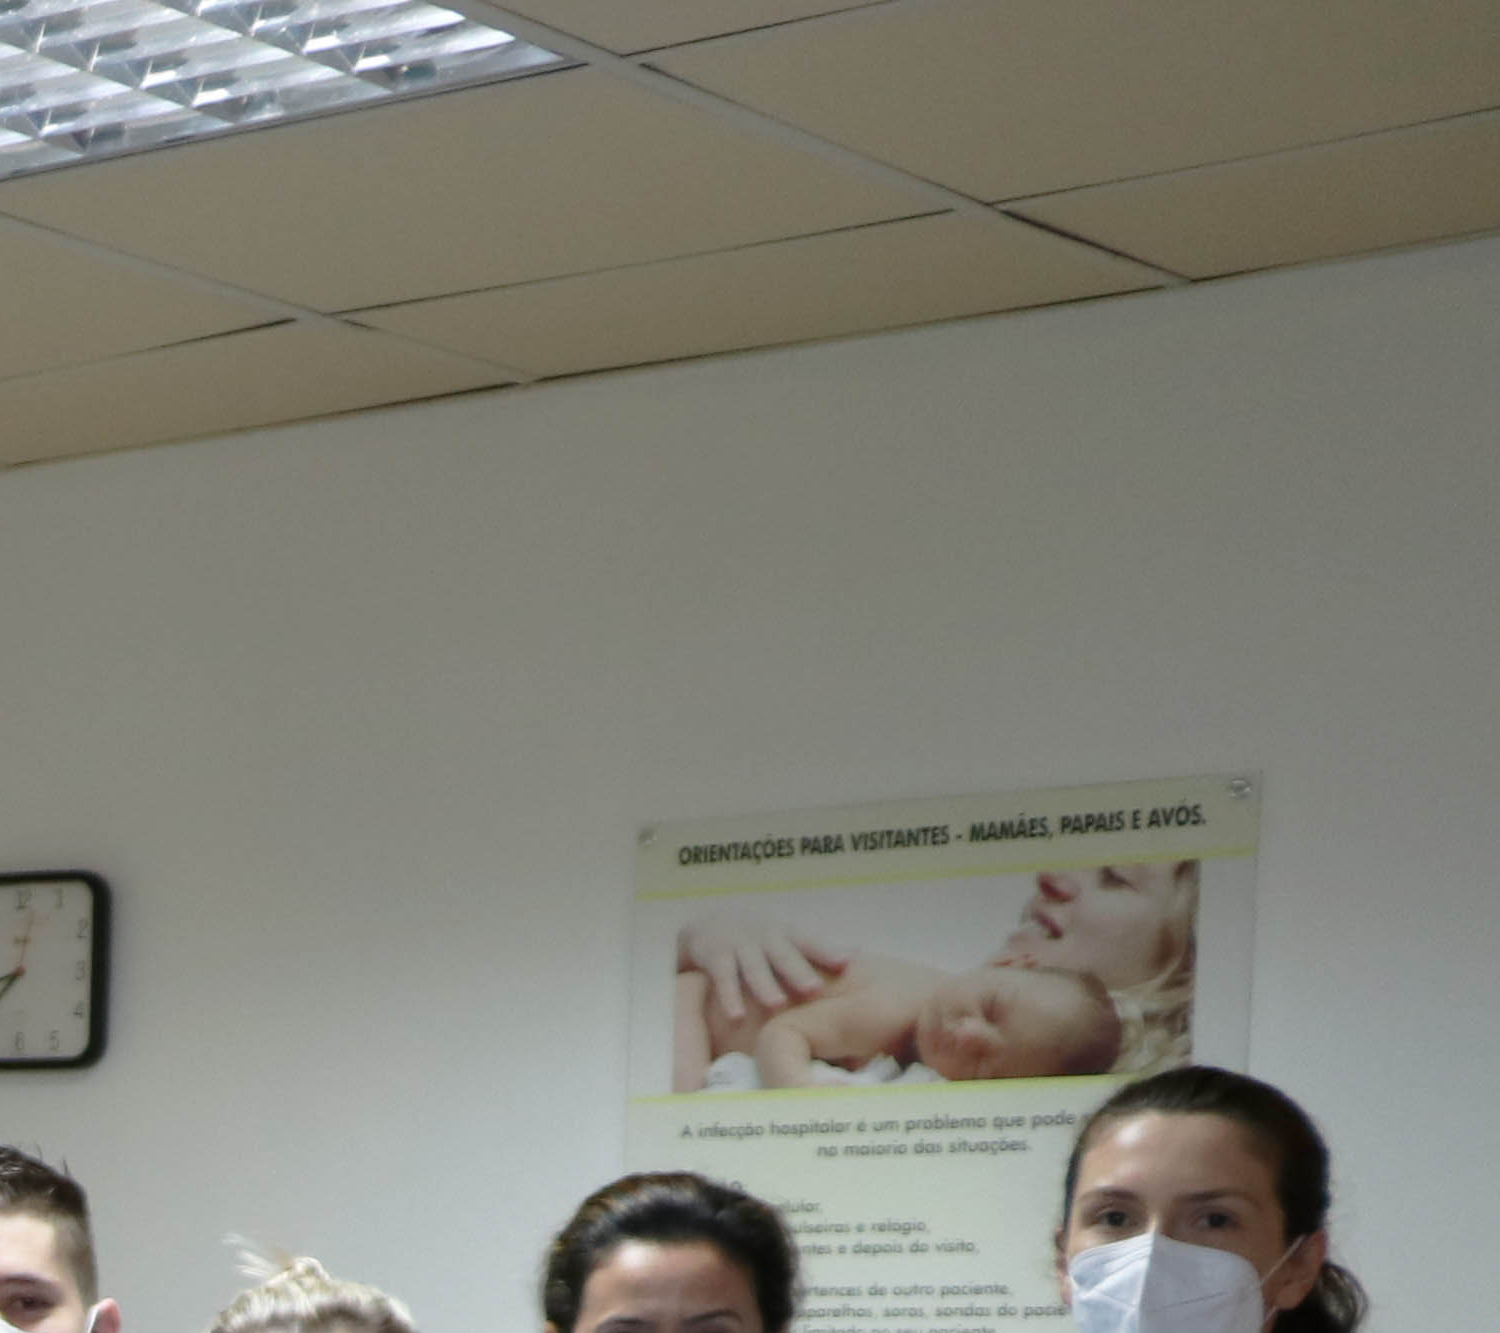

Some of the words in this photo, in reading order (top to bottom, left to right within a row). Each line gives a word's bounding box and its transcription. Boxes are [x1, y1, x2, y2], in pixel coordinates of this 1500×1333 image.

[678, 832, 795, 866] ORIENTAÇÕES
[800, 834, 845, 856] PARA
[850, 824, 950, 852] VISITANTES
[1060, 810, 1126, 836] PAPAIS
[1131, 810, 1142, 830] E
[15, 1031, 25, 1051] 6
[681, 1124, 692, 1138] A
[698, 1122, 764, 1140] infecção
[770, 1118, 852, 1138] hospitalar
[873, 1119, 900, 1132] um
[905, 1113, 987, 1133] problema
[993, 1114, 1026, 1131] que
[1031, 1109, 1077, 1129] pode
[914, 1138, 942, 1154] das
[852, 1239, 902, 1256] depois
[867, 1282, 887, 1297] de
[893, 1283, 934, 1297] outro
